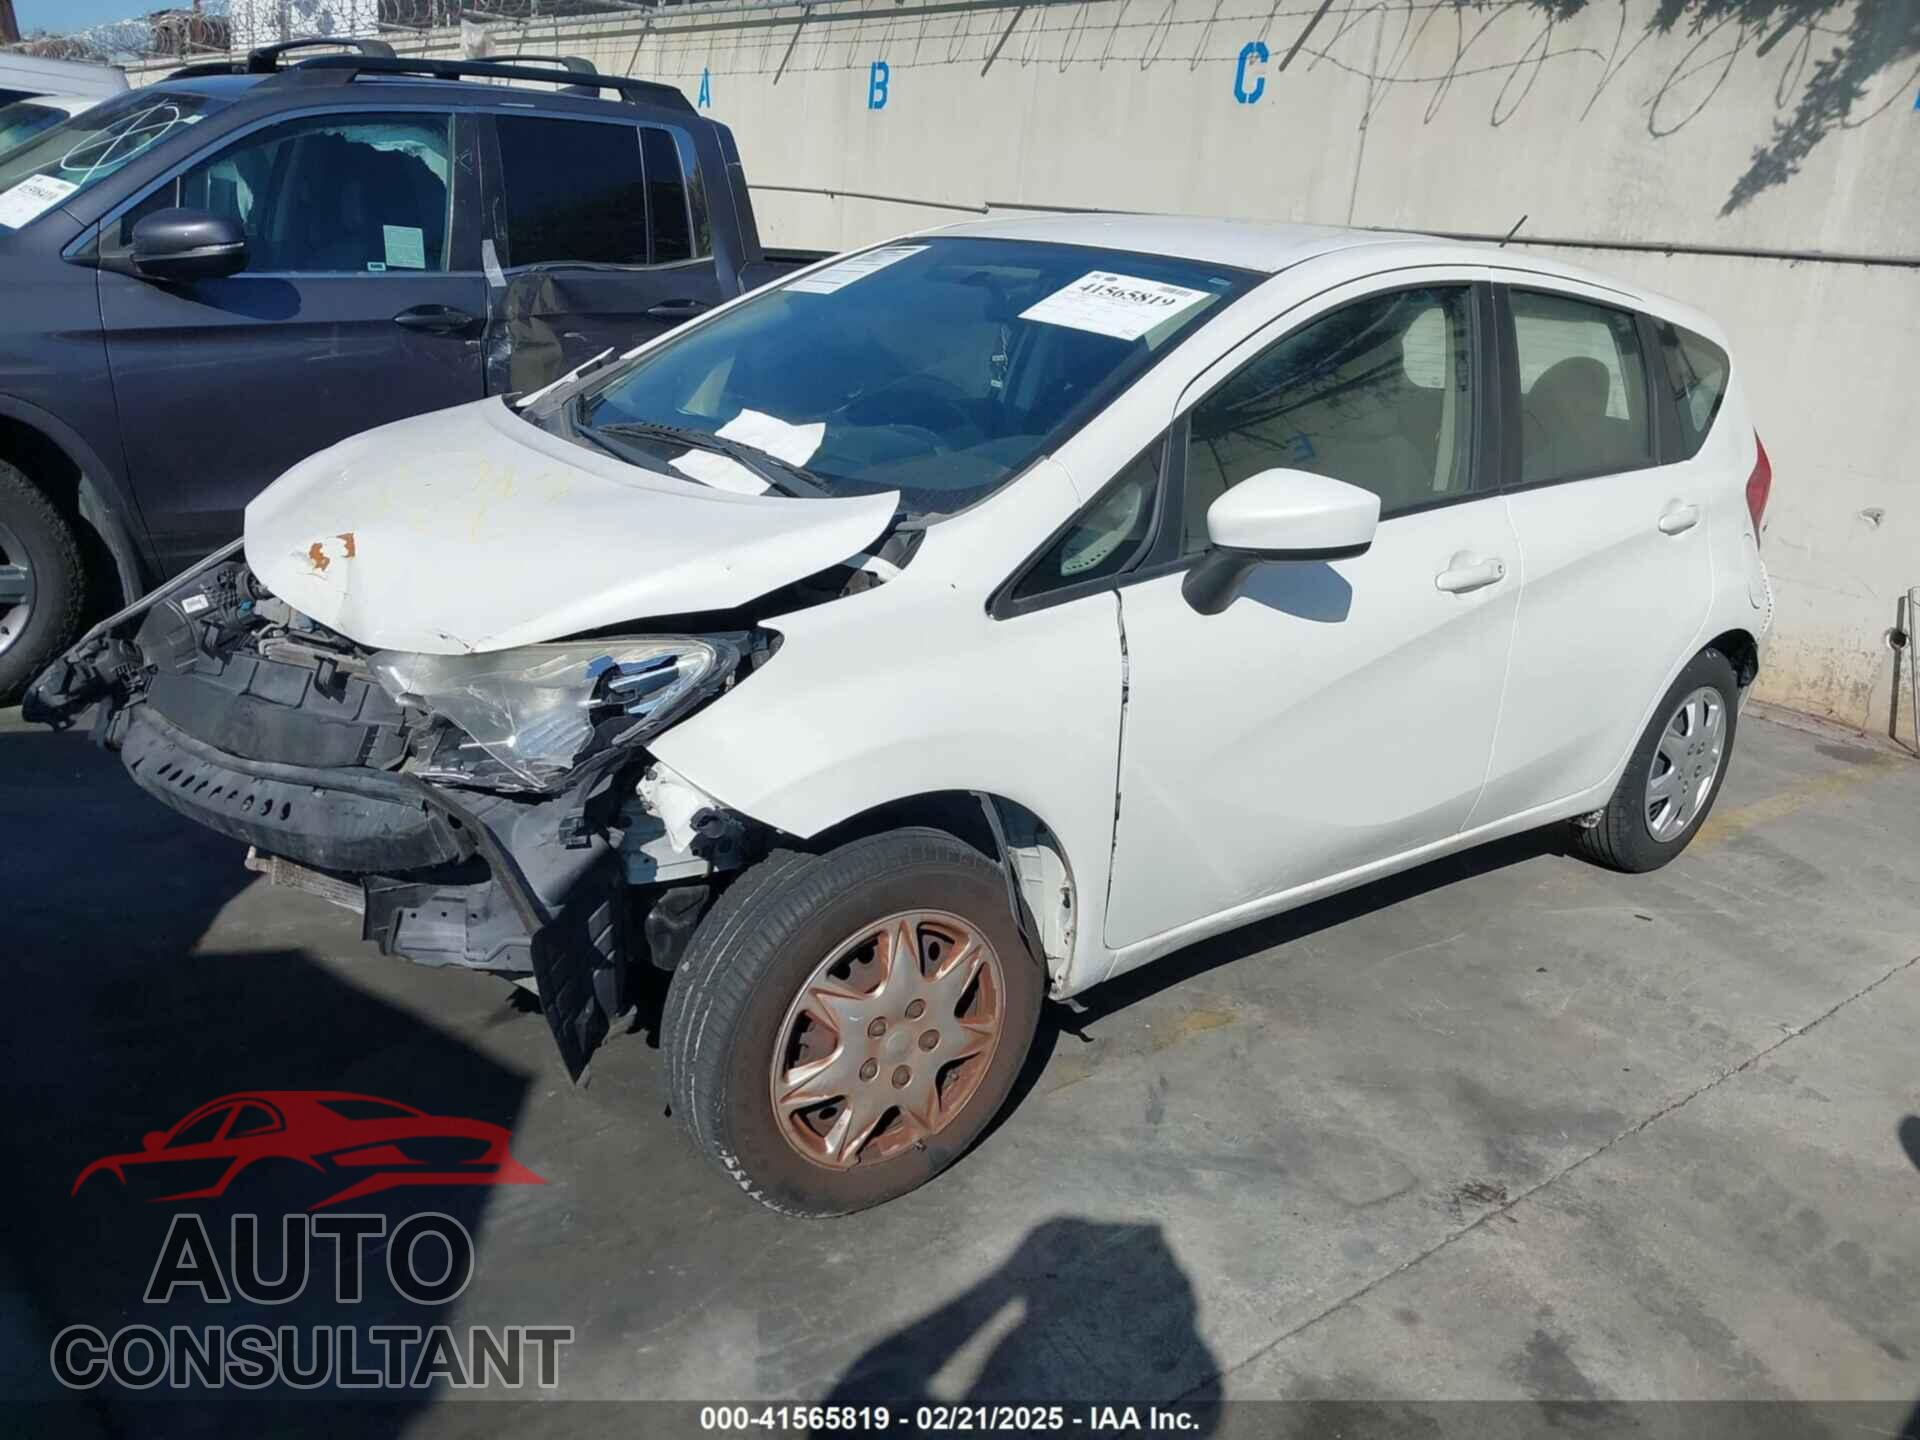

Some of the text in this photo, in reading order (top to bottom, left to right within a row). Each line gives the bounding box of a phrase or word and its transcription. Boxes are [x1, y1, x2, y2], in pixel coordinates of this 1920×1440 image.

[698, 67, 711, 108] A
[868, 61, 890, 110] B
[1234, 41, 1269, 104] C
